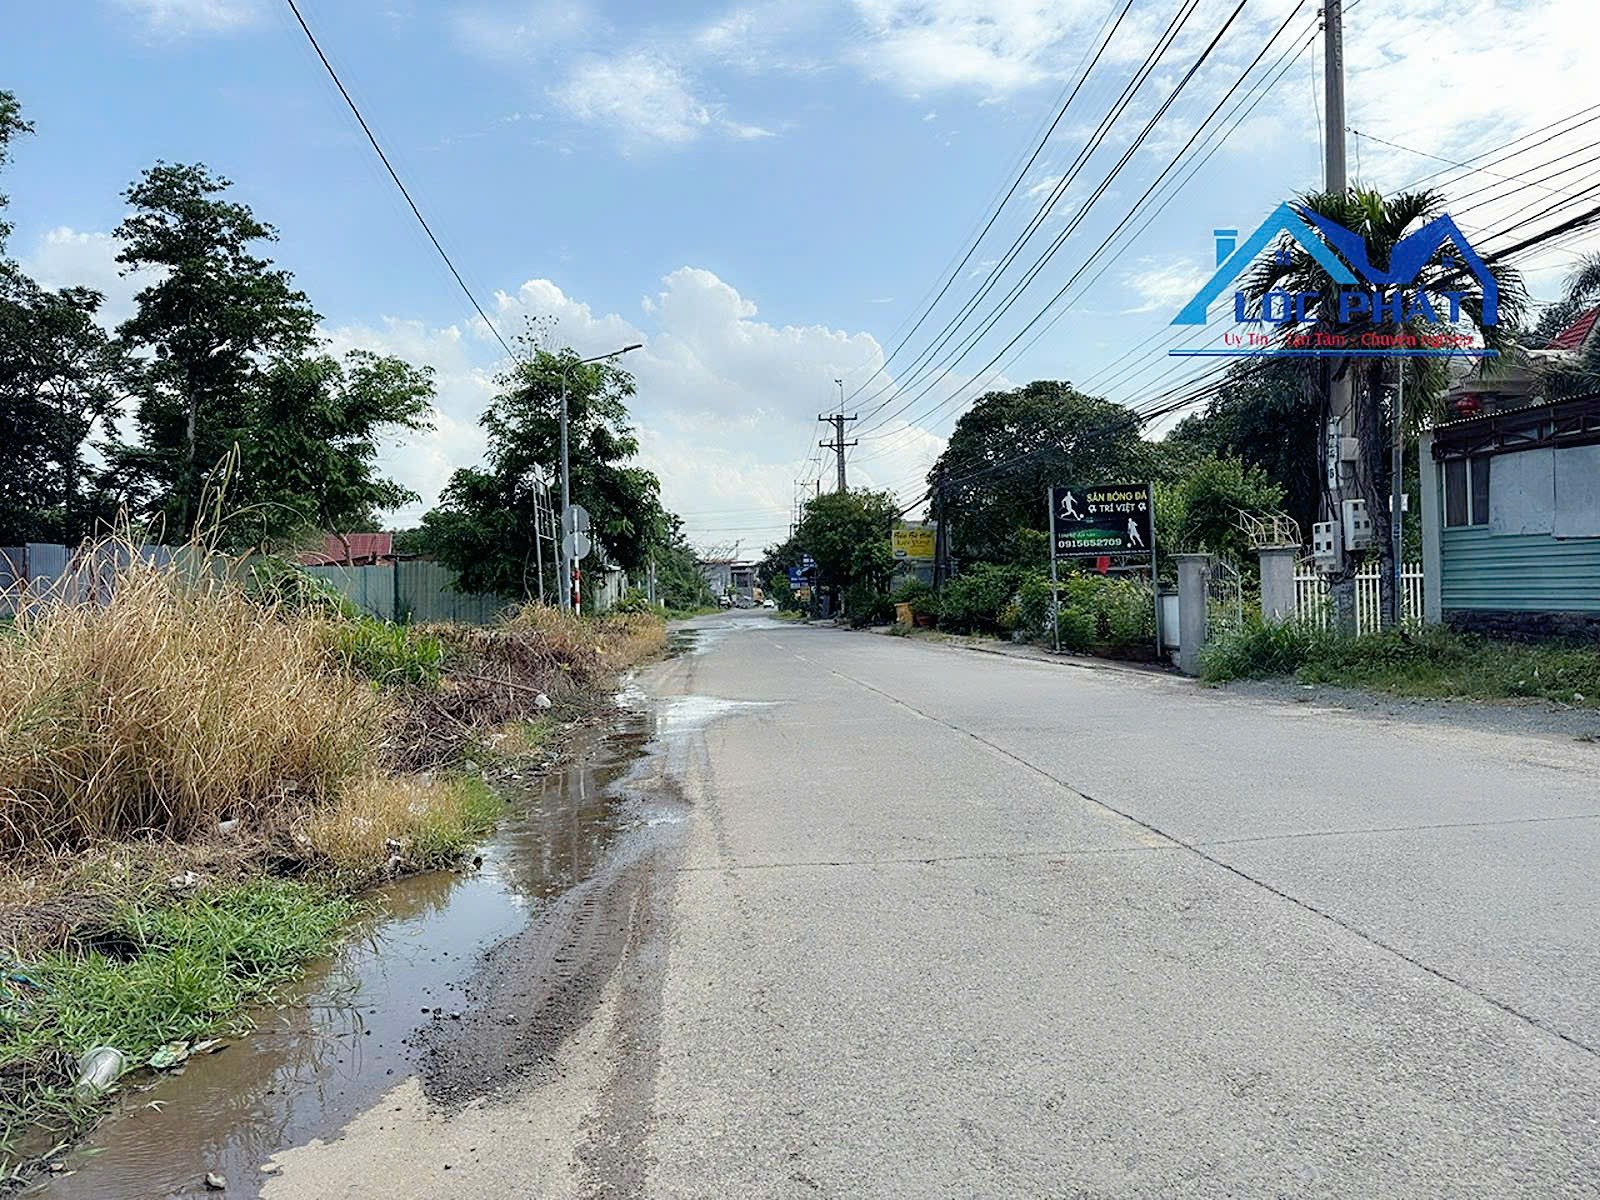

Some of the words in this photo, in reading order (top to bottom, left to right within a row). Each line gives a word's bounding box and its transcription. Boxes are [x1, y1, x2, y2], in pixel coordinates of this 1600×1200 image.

[1086, 491, 1105, 503] SÂN
[1106, 490, 1133, 501] BÓNG
[1134, 489, 1148, 500] ĐÁ
[1099, 502, 1114, 513] TRÍ
[1115, 502, 1136, 513] VIỆT
